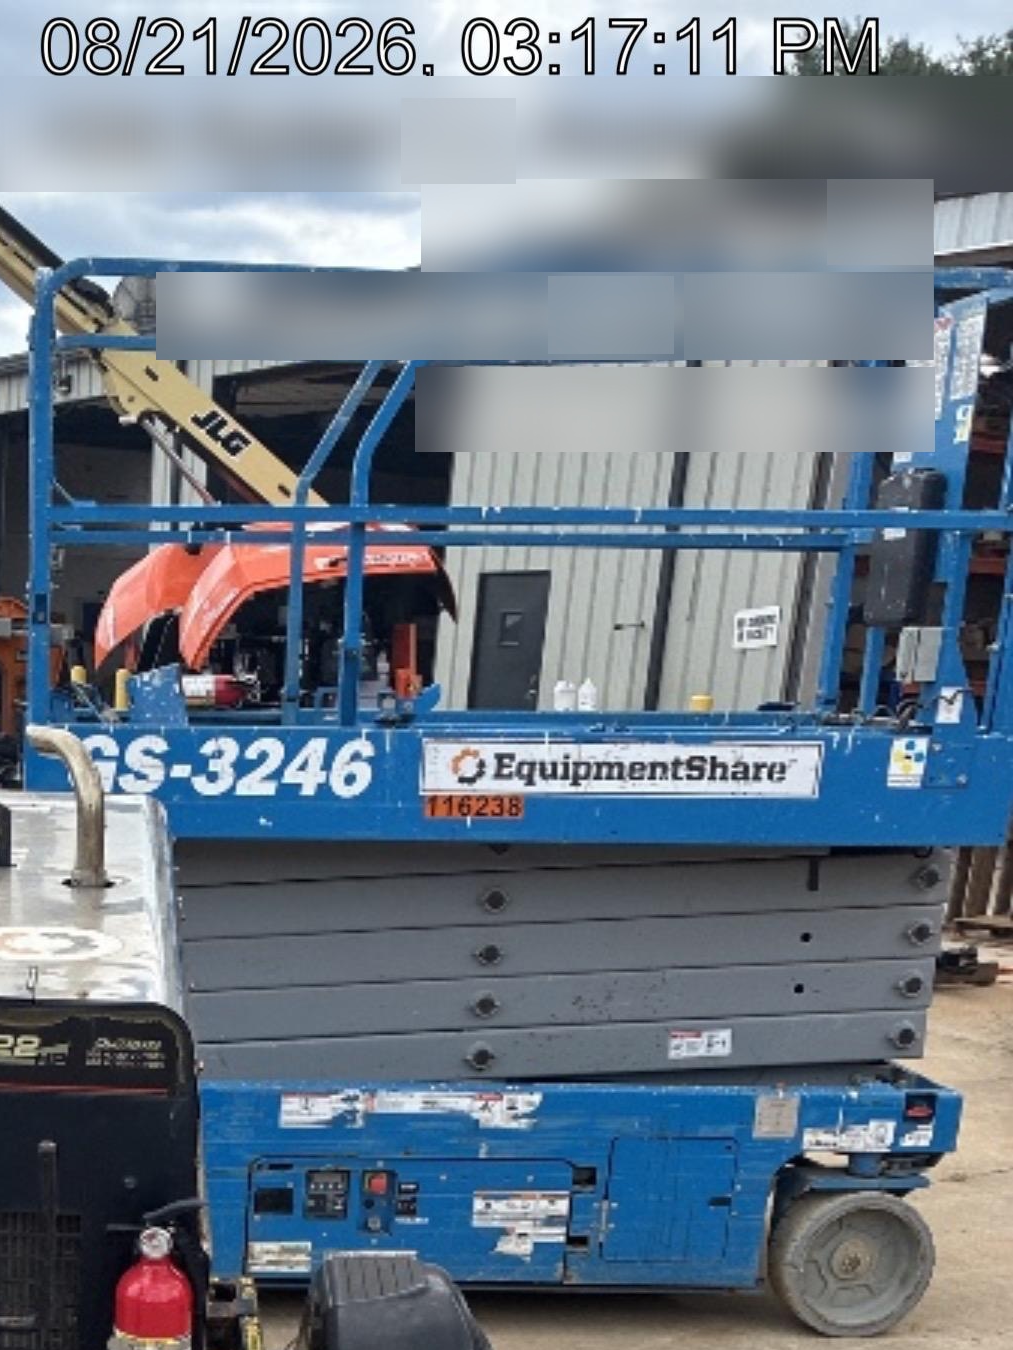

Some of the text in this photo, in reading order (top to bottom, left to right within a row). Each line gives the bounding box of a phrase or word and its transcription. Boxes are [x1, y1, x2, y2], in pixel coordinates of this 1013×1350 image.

[190, 408, 252, 456] JLG
[68, 734, 375, 797] GS-3246
[493, 751, 787, 787] EquipmentShare
[428, 795, 523, 817] 116238
